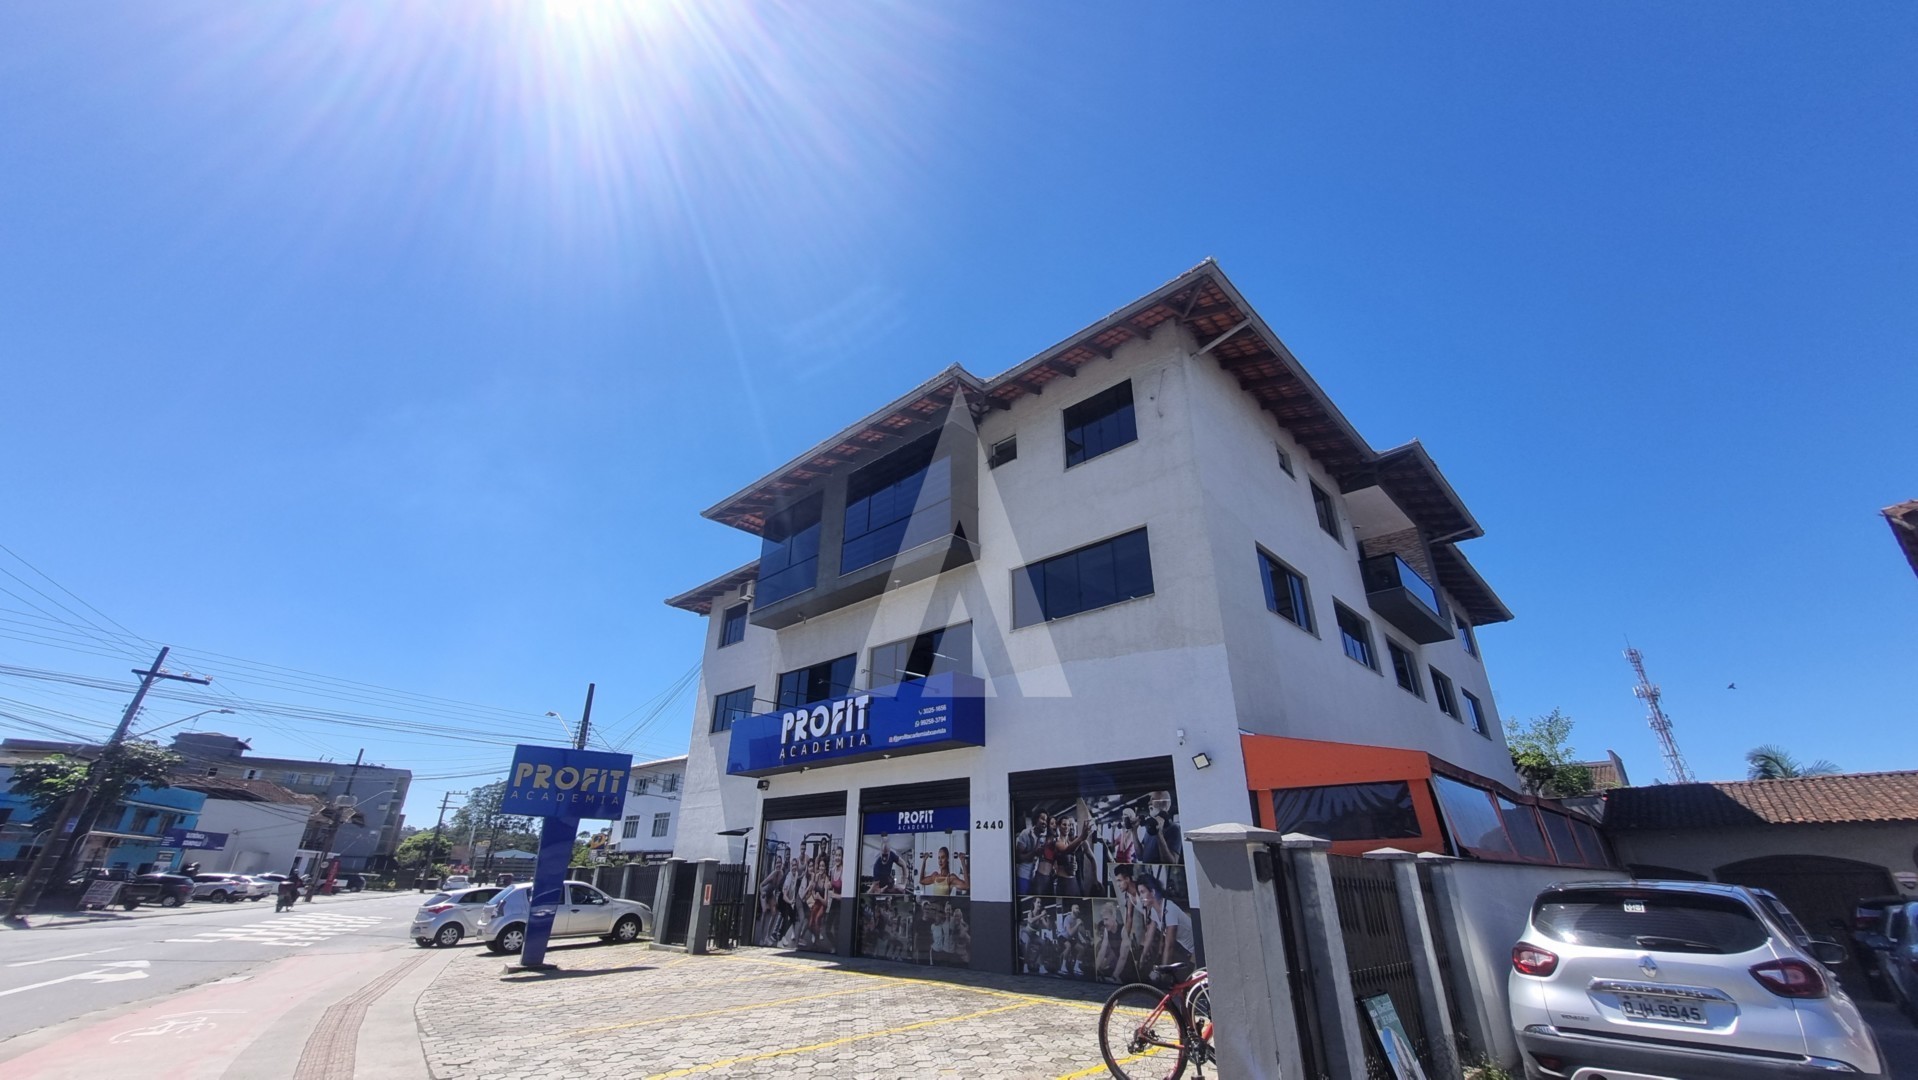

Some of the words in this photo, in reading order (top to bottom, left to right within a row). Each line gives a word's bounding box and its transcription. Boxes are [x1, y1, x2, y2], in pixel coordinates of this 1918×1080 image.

[781, 695, 870, 744] PROFIT
[779, 733, 867, 759] ACADEMIA
[513, 763, 625, 794] PROFIT
[511, 791, 619, 805] ACADEMIA
[898, 810, 934, 825] PROFIT
[975, 820, 1004, 830] 2440
